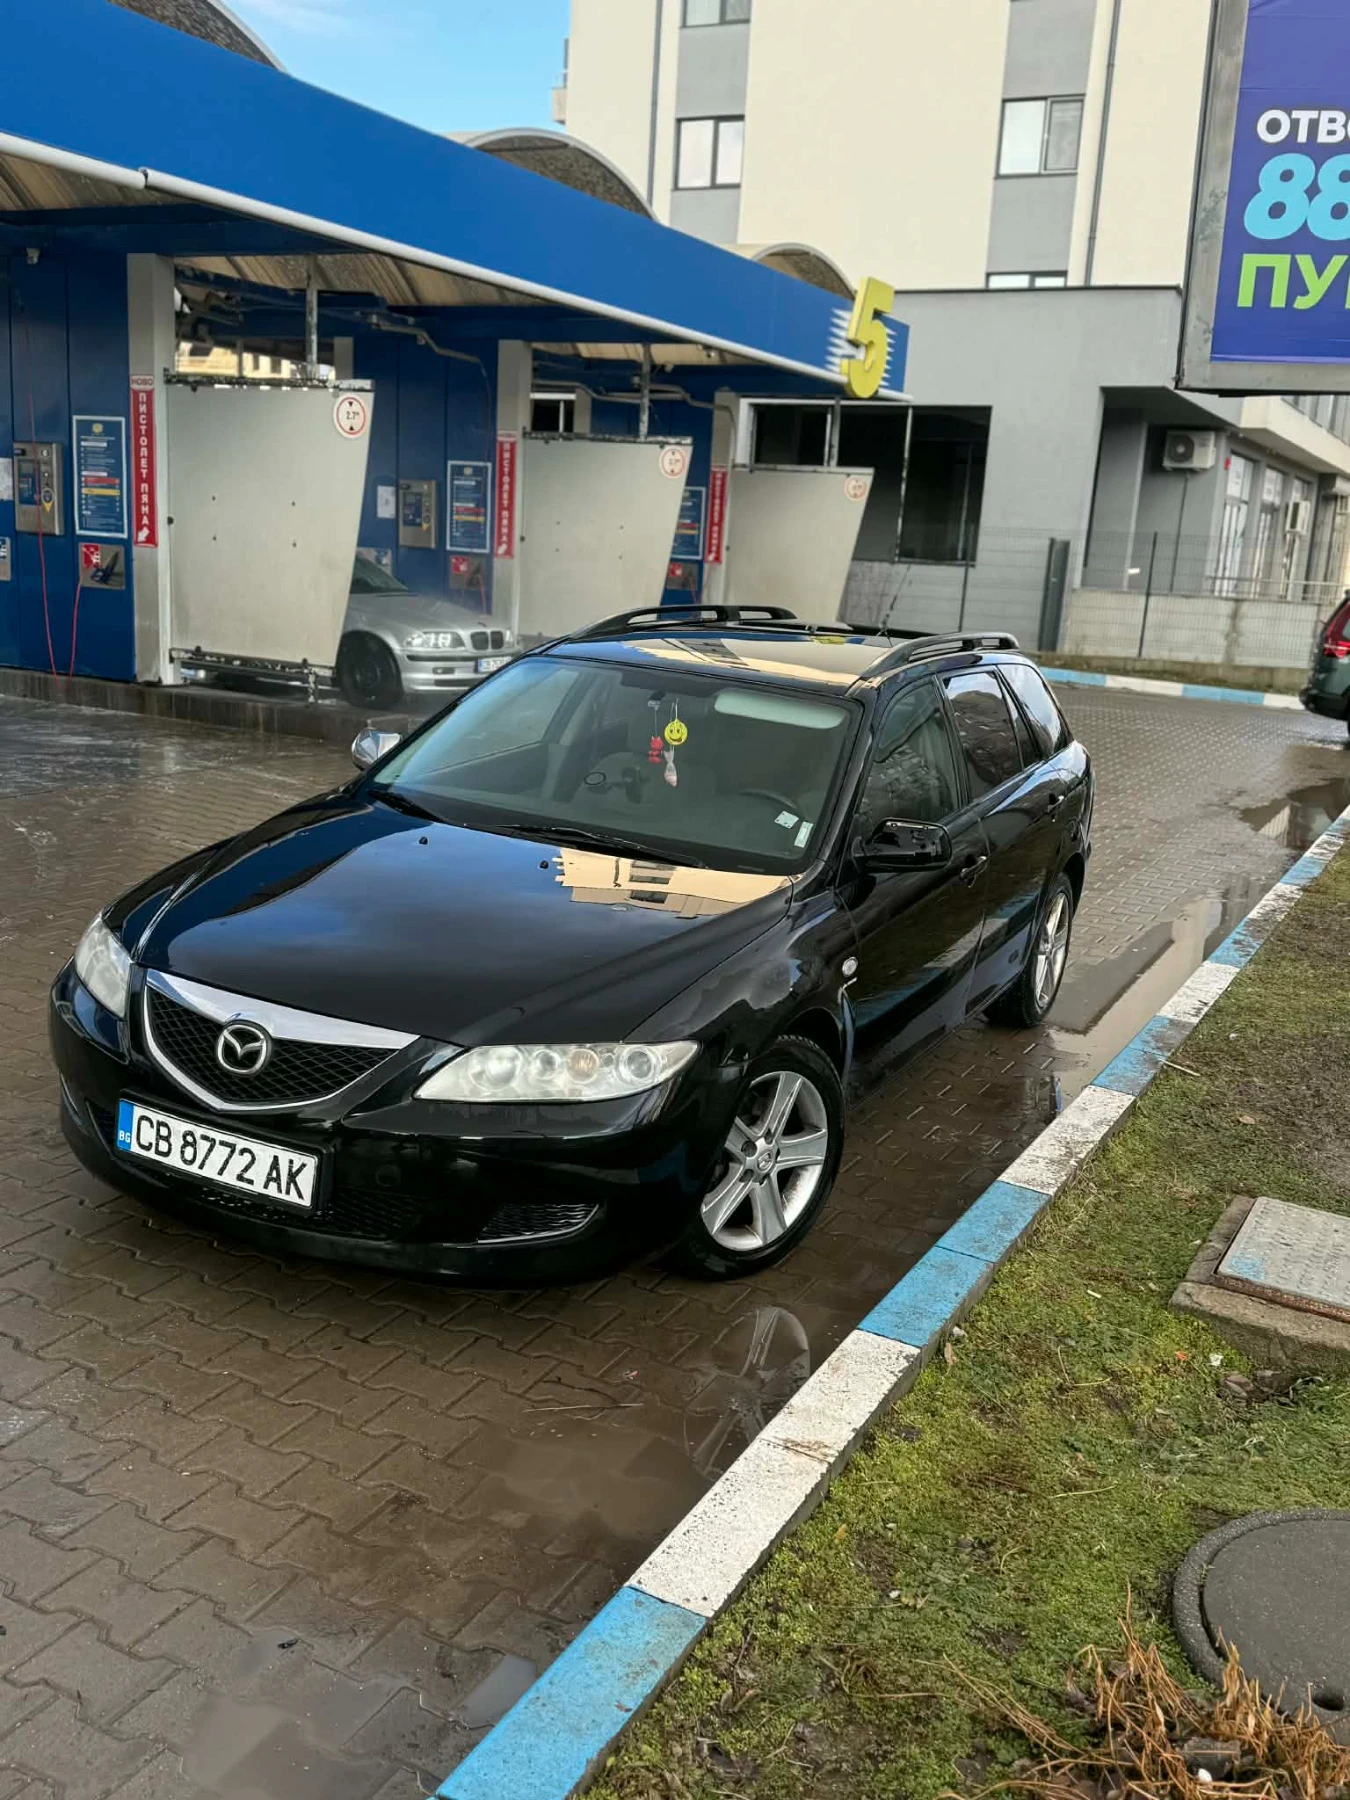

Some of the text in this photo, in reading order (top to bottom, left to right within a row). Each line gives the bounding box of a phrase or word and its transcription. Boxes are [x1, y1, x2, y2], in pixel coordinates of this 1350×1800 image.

[1257, 109, 1350, 143] ОТВ
[1237, 253, 1350, 309] ПУ
[840, 276, 895, 399] 5
[132, 377, 154, 386] НОВО
[141, 483, 150, 525] ПЯНА
[118, 1131, 131, 1143] BG
[136, 1115, 307, 1200] CB 8772 AK
